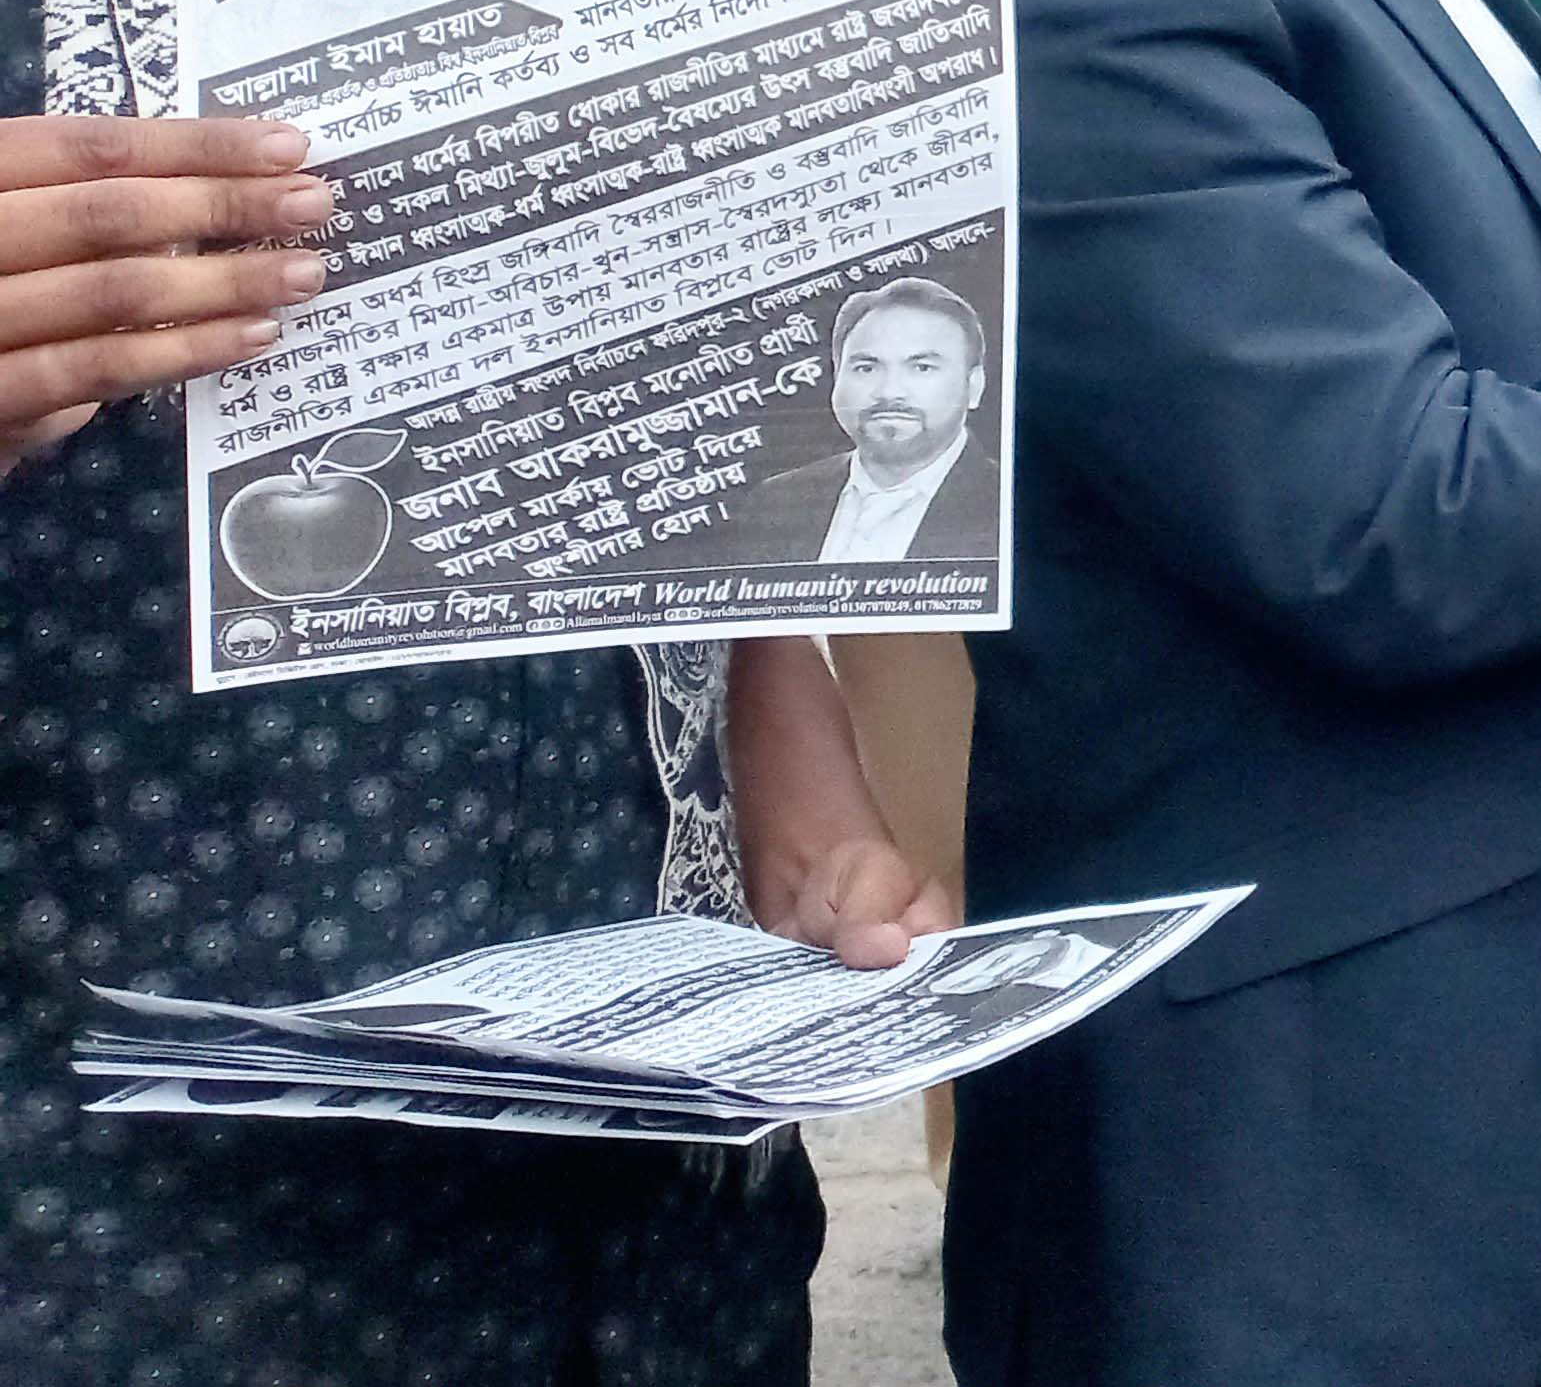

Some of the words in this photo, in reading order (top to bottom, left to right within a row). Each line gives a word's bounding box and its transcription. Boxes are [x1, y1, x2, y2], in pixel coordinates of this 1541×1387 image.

[212, 57, 319, 105] আল্লামা
[326, 31, 406, 71] ইমাম
[413, 2, 503, 44] হায়াত
[320, 100, 401, 141] সর্বোচ্চ
[409, 72, 482, 113] ঈমানি
[489, 50, 559, 89] কর্তব্য
[569, 45, 589, 63] ও
[597, 29, 634, 54] সব
[644, 2, 702, 41] ধর্মের
[350, 160, 403, 191] নামে
[412, 134, 470, 173] ধর্মের
[475, 111, 558, 155] বিপরীত
[568, 85, 640, 126] ধোকার
[645, 51, 748, 100] রাজনীতির
[752, 27, 824, 64] মাধ্যমে
[828, 10, 867, 41] রাষ্ট্র
[291, 302, 351, 331] নামে
[361, 271, 422, 308] অধর্ম
[432, 260, 490, 291] হিংস্র
[498, 220, 599, 268] জঙ্গিবাদি
[608, 170, 755, 234] স্বৈররাজনীতি
[766, 163, 785, 179] ও
[793, 126, 877, 170] বস্তুবাদি
[886, 87, 988, 137] জাতিবাদি
[858, 147, 917, 183] থেকে
[926, 122, 998, 155] জীবন,
[215, 395, 351, 452] রাজনীতির
[364, 362, 459, 404] একমাত্র
[471, 345, 512, 370] দল
[520, 293, 664, 352] ইনসানিয়াত
[673, 264, 751, 305] বিপ্লবে
[763, 239, 819, 274] ভোট
[827, 221, 874, 252] দিন
[219, 387, 256, 417] ধর্ম
[270, 384, 291, 401] ও
[301, 363, 347, 393] রাষ্ট্র
[356, 341, 428, 376] রক্ষার
[442, 308, 533, 349] একমাত্র
[542, 282, 610, 316] উপায়
[619, 242, 728, 288] মানবতার
[737, 216, 806, 251] রাষ্ট্রের
[815, 190, 880, 222] লক্ষ্যে
[889, 152, 991, 197] মানবতার
[396, 468, 503, 518] জনাব
[506, 356, 824, 479] আকরামুজ্জামান-কে
[411, 407, 564, 472] ইনসানিয়াত
[568, 381, 640, 423] বিপ্লব
[643, 341, 753, 393] মনোনীত
[760, 312, 817, 354] প্রার্থী
[410, 507, 516, 551] আপেল
[520, 475, 612, 515] মার্কায়
[622, 447, 687, 487] ভোট
[692, 425, 761, 463] দিয়ে
[435, 521, 573, 576] মানবতার
[574, 499, 629, 532] রাষ্ট্র
[636, 462, 745, 511] প্রতিষ্ঠায়
[522, 527, 643, 582] অংশীদার
[652, 505, 710, 540] হোন
[290, 598, 441, 639] ইনসানিয়াত
[445, 590, 520, 627] বিপ্লব,
[528, 581, 648, 613] বাংলাদেশ
[655, 580, 731, 606] World
[738, 572, 858, 606] humanity
[864, 571, 990, 597] revolution
